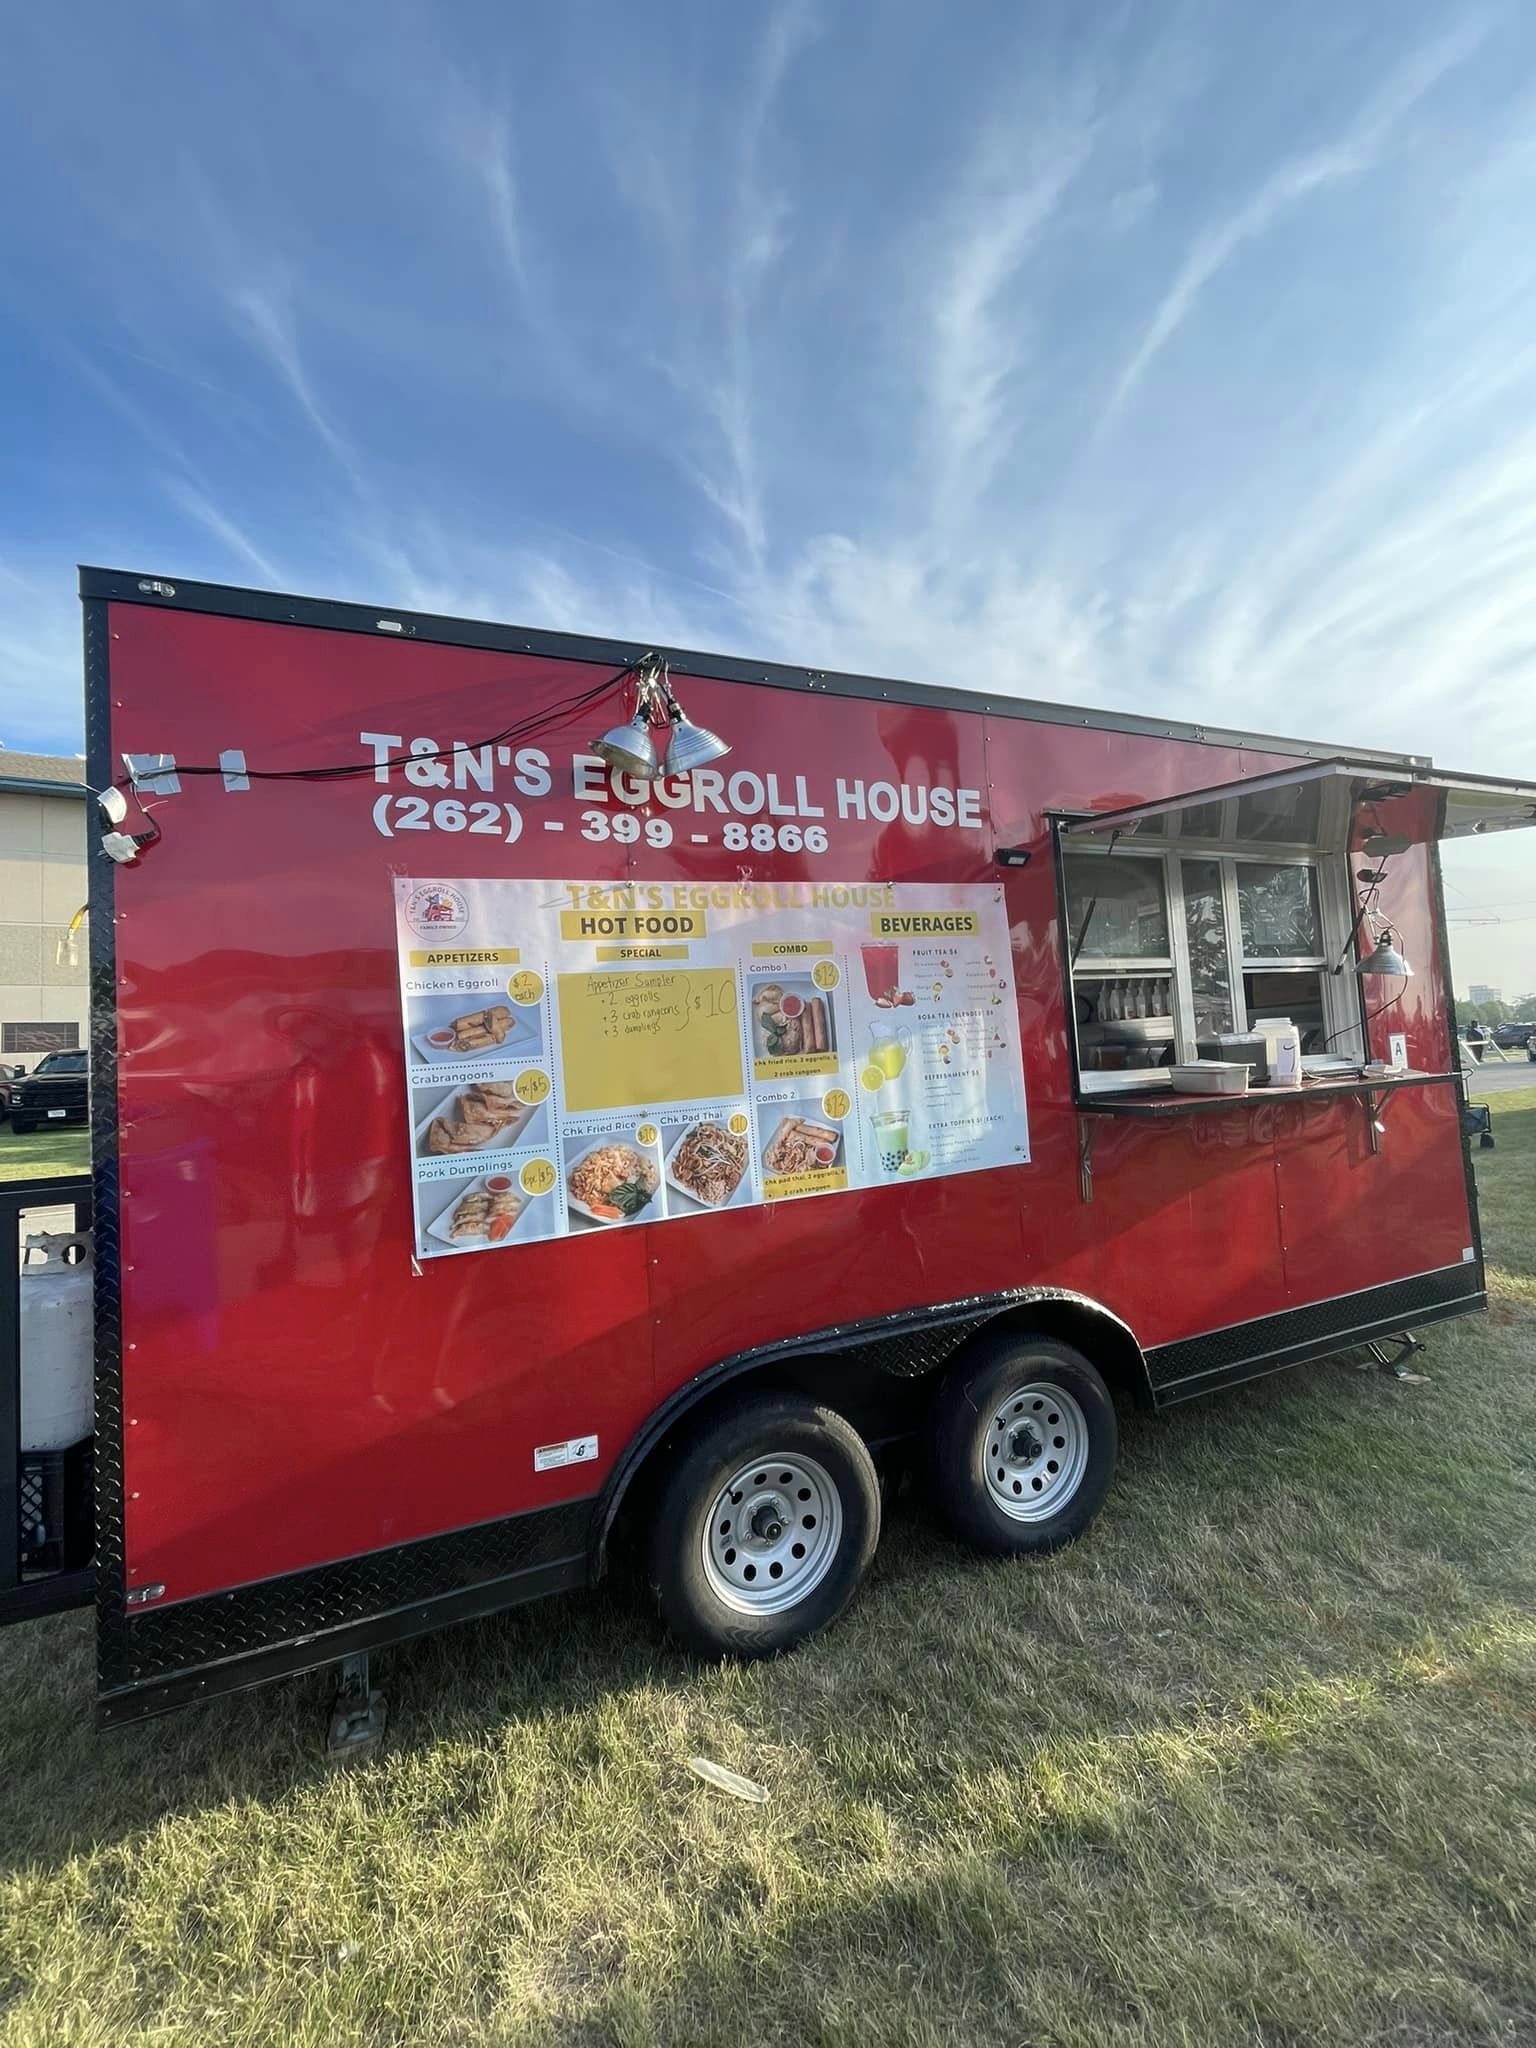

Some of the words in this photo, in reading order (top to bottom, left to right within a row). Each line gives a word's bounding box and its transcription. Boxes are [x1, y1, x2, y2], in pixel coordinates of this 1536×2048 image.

[360, 731, 551, 797] T&N'S
[573, 753, 825, 818] EGGROLL
[836, 778, 983, 828] HOUSE
[372, 794, 523, 844] (262)
[580, 810, 673, 849] 399
[723, 822, 829, 853] 8866
[566, 885, 664, 910] T&N'S
[673, 885, 804, 910] EGGROLL
[811, 886, 895, 909] HOUSE
[581, 917, 627, 935] HOT
[635, 916, 694, 934] FOOD
[881, 916, 973, 932] BEVERAGES
[620, 949, 662, 958] SPECIAL
[773, 944, 808, 954] COMBO
[427, 952, 499, 963] APPETIZERS
[750, 964, 782, 973] Combo
[406, 980, 454, 990] Chicken
[458, 978, 499, 990] Eggroll
[513, 974, 532, 988] $2
[609, 992, 618, 1005] 2
[625, 991, 661, 1007] eggrolls
[610, 1009, 618, 1023] 3
[623, 1008, 641, 1020] crab
[611, 1025, 619, 1037] 3
[1395, 1041, 1402, 1056] A
[411, 1070, 495, 1085] Crabrangoons
[755, 1092, 788, 1103] Combo
[790, 1091, 796, 1099] 2
[660, 1116, 680, 1125] Chk
[682, 1114, 701, 1123] Pad
[703, 1112, 723, 1120] Thai
[562, 1127, 585, 1137] Chk
[587, 1123, 613, 1134] Fried
[615, 1121, 637, 1130] Rice
[418, 1168, 446, 1179] Pork
[449, 1161, 513, 1177] Dumplings
